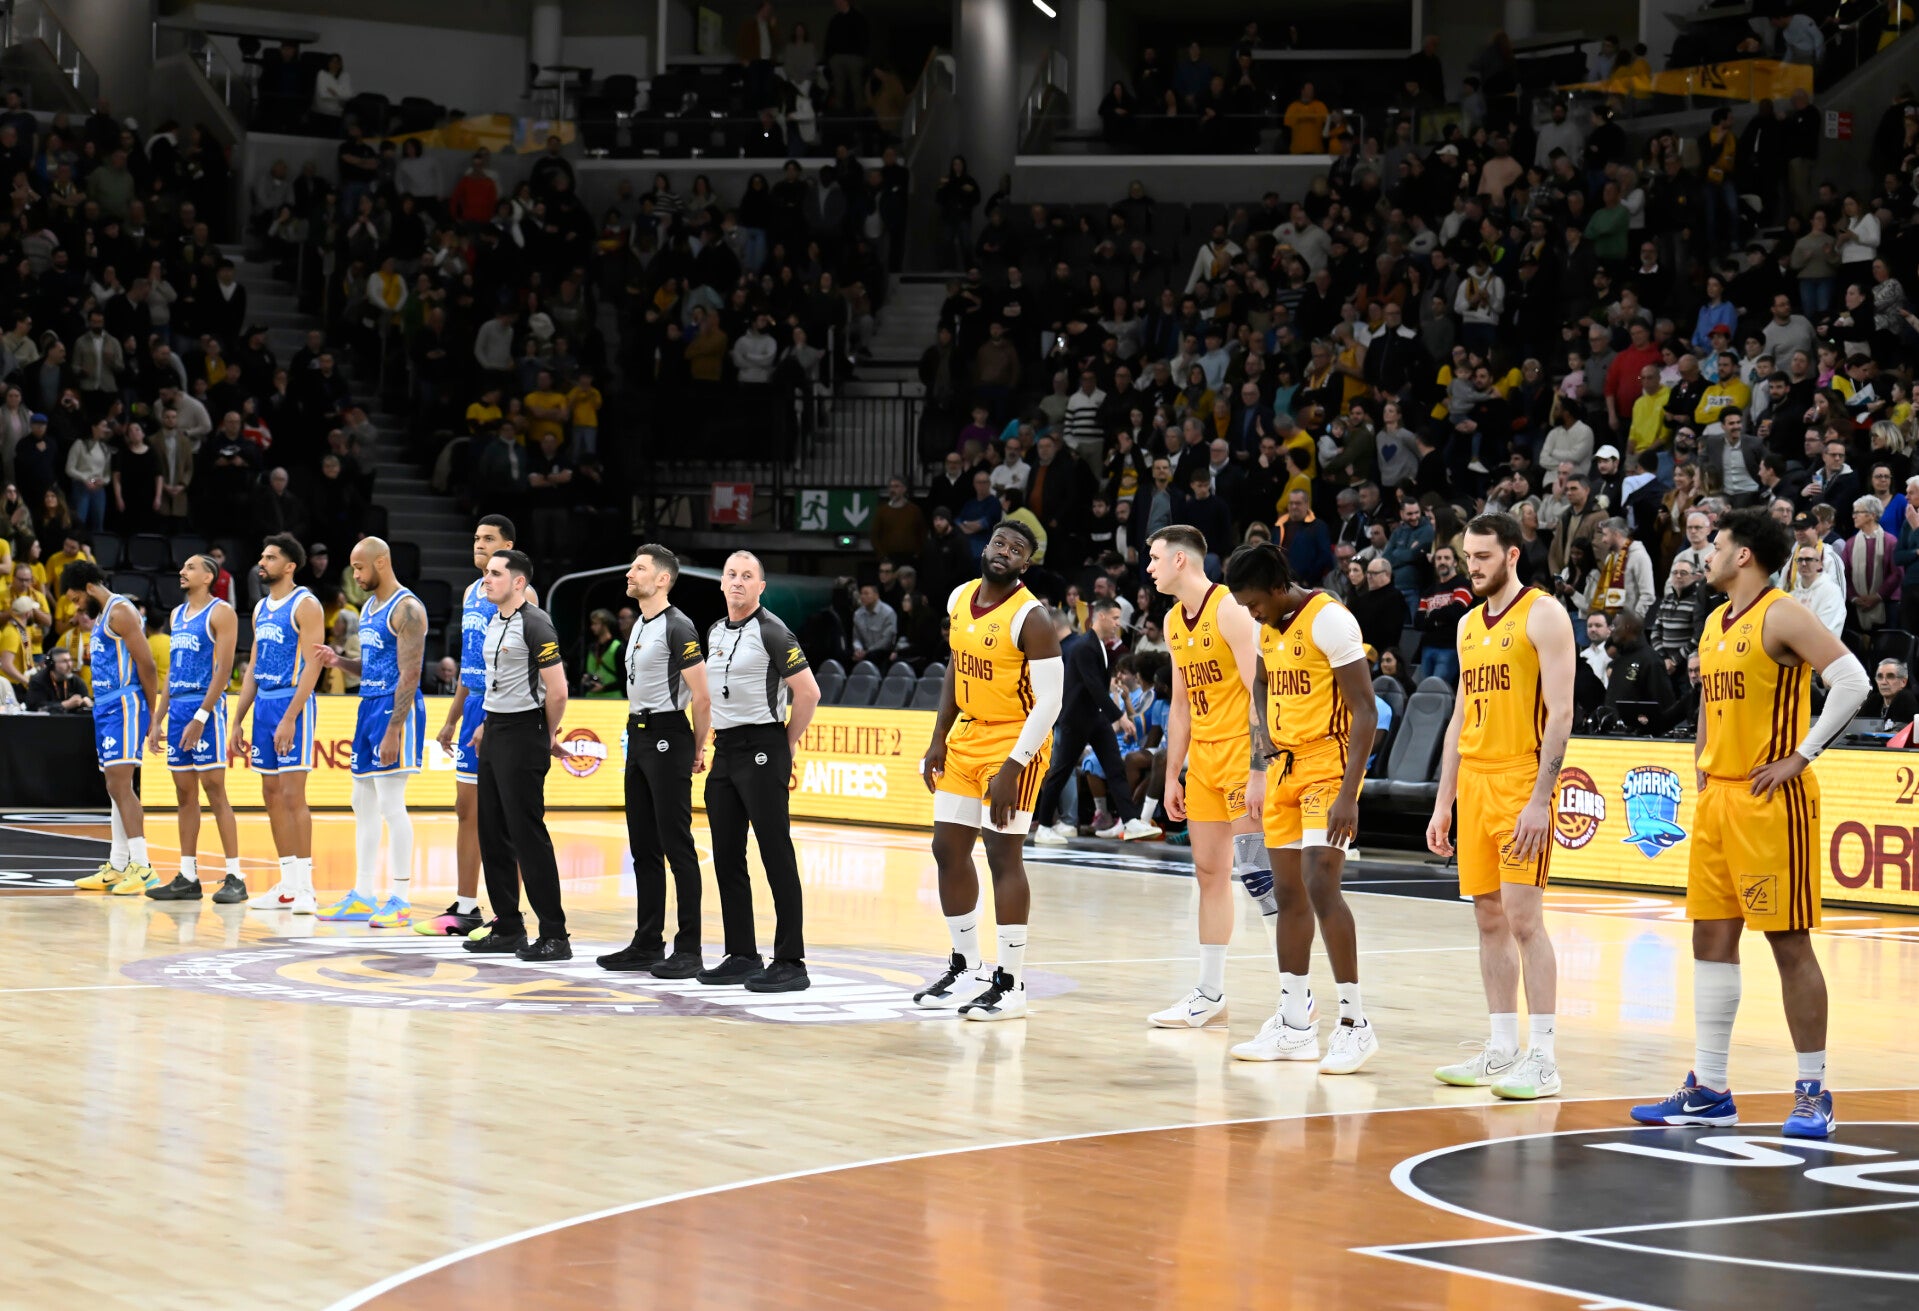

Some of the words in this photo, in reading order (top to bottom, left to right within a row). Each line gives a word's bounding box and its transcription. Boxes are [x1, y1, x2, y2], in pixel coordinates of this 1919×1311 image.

[984, 637, 994, 647] U
[1203, 637, 1211, 646] U
[1501, 637, 1510, 647] U
[1736, 642, 1746, 652] U
[1294, 646, 1302, 656] U
[1276, 703, 1281, 730] 2
[832, 725, 886, 756] ELITE
[891, 728, 902, 756] 2
[801, 760, 888, 799] ANTIBES
[1622, 770, 1682, 803] SHARKS
[1811, 800, 1817, 819] 1
